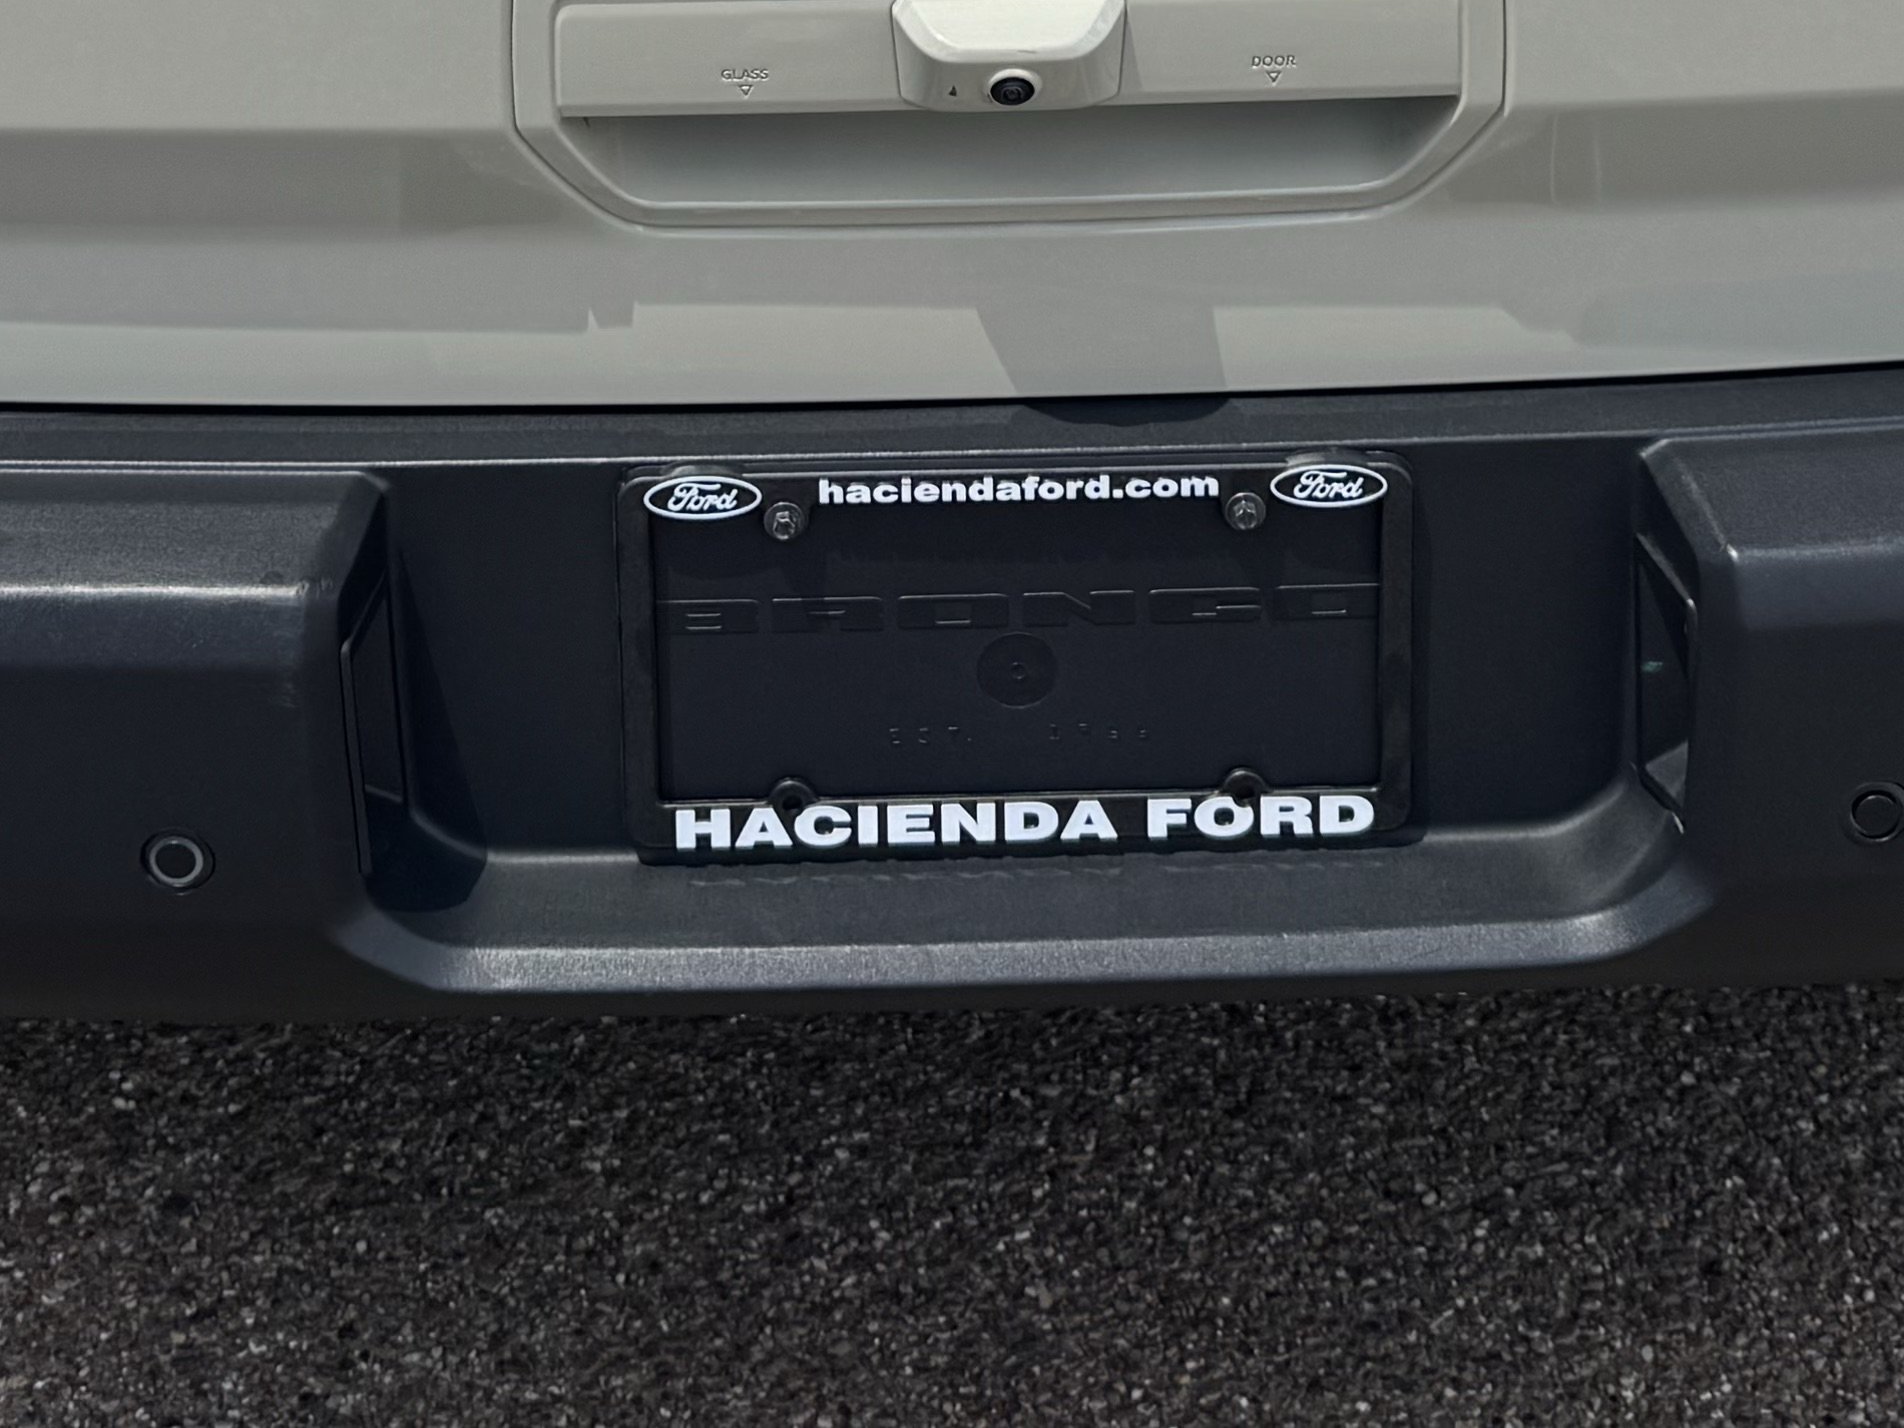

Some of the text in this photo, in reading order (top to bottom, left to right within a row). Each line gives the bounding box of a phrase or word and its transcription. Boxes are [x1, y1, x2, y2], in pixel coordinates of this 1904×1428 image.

[720, 68, 770, 82] GLASS
[1251, 54, 1297, 68] DOOR
[667, 482, 739, 512] Ford
[817, 474, 1220, 505] haciendaford.com
[1293, 470, 1365, 499] Ford
[656, 582, 1380, 635] BRONCO
[673, 794, 1376, 852] HACIENDA FORD
